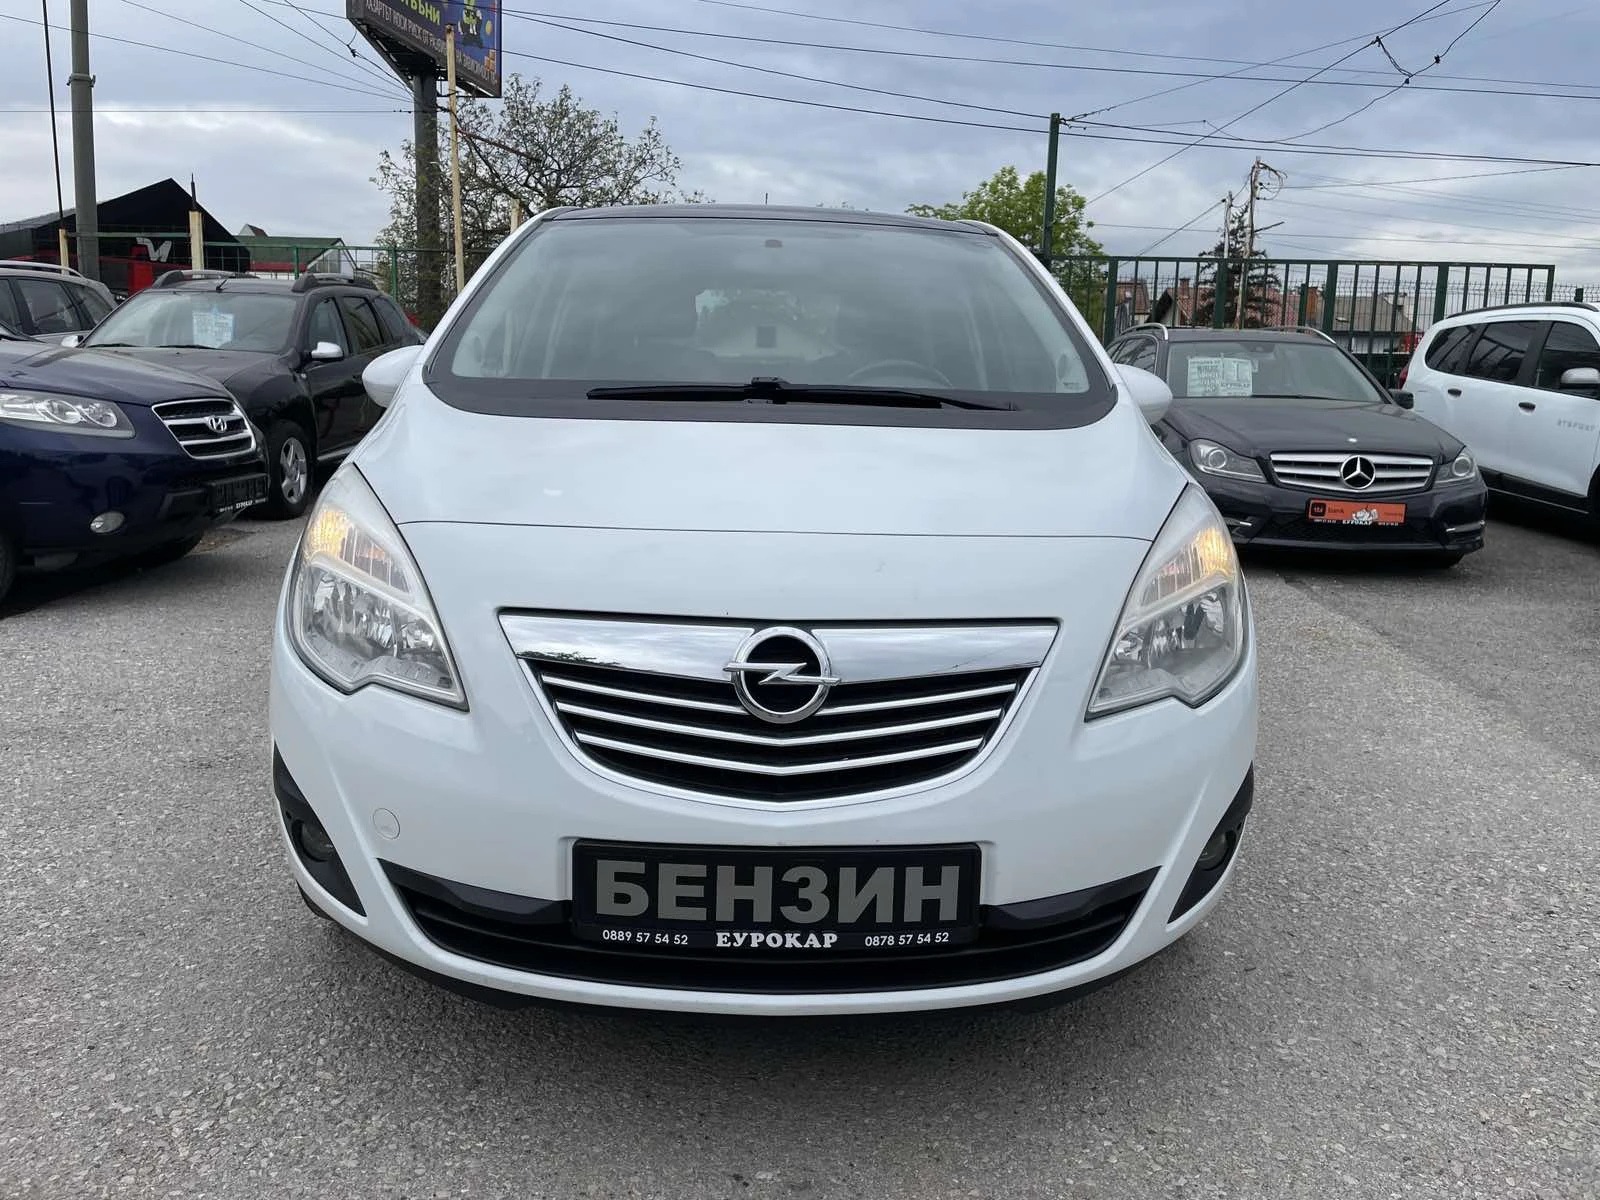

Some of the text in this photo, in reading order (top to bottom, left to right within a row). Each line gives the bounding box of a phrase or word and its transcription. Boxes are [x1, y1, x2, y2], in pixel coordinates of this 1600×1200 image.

[596, 859, 961, 924] БЕНЗИН
[602, 929, 689, 945] 0889 57 54 52
[715, 932, 838, 948] ЕУРОКАР
[864, 931, 950, 947] 0878 57 54 52
